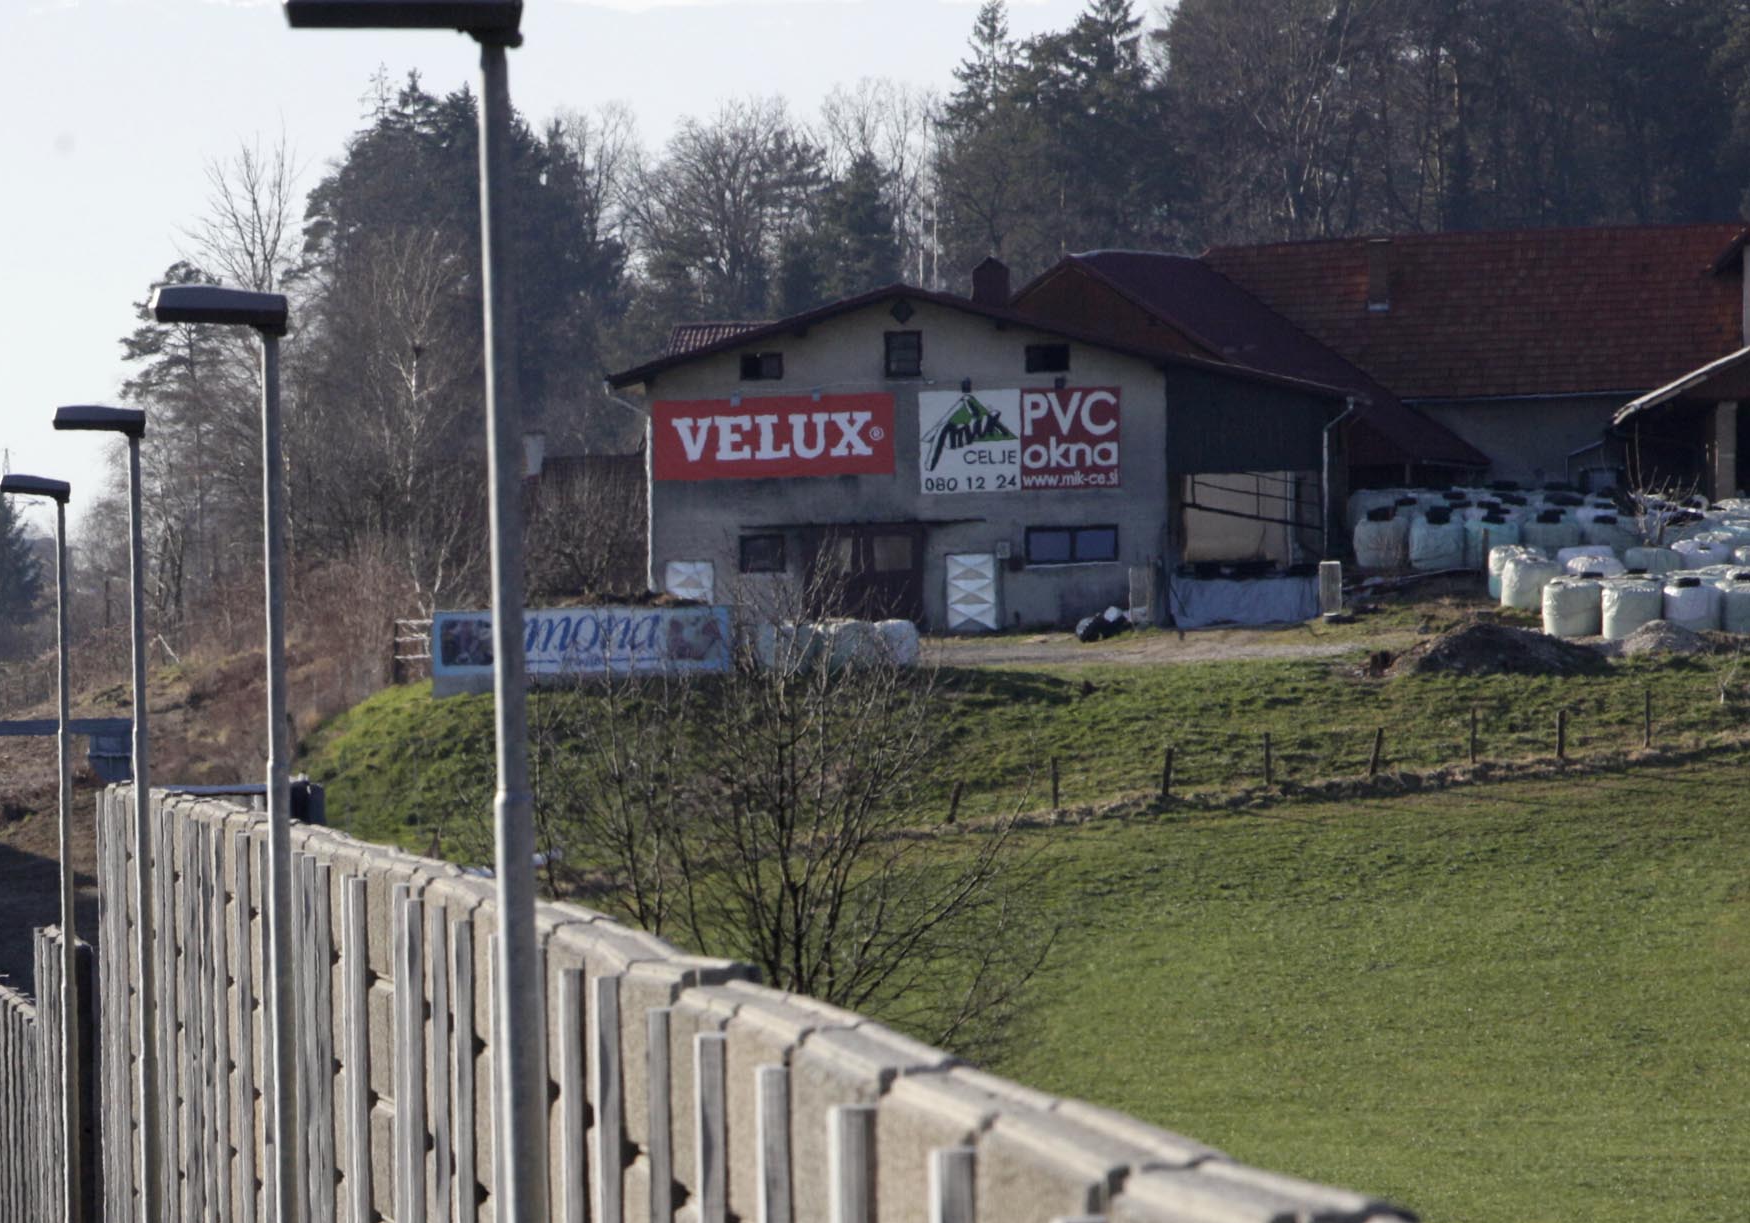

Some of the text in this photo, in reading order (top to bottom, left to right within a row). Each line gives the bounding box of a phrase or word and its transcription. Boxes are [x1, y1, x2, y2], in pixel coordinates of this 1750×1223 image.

[1023, 391, 1118, 436] PVC
[671, 411, 874, 462] VELUX
[1023, 436, 1119, 469] okna
[963, 450, 1017, 465] CELJE
[924, 475, 1018, 491] 080 12 24
[1022, 469, 1119, 487] www.mik-ce.si
[524, 614, 660, 653] mona
